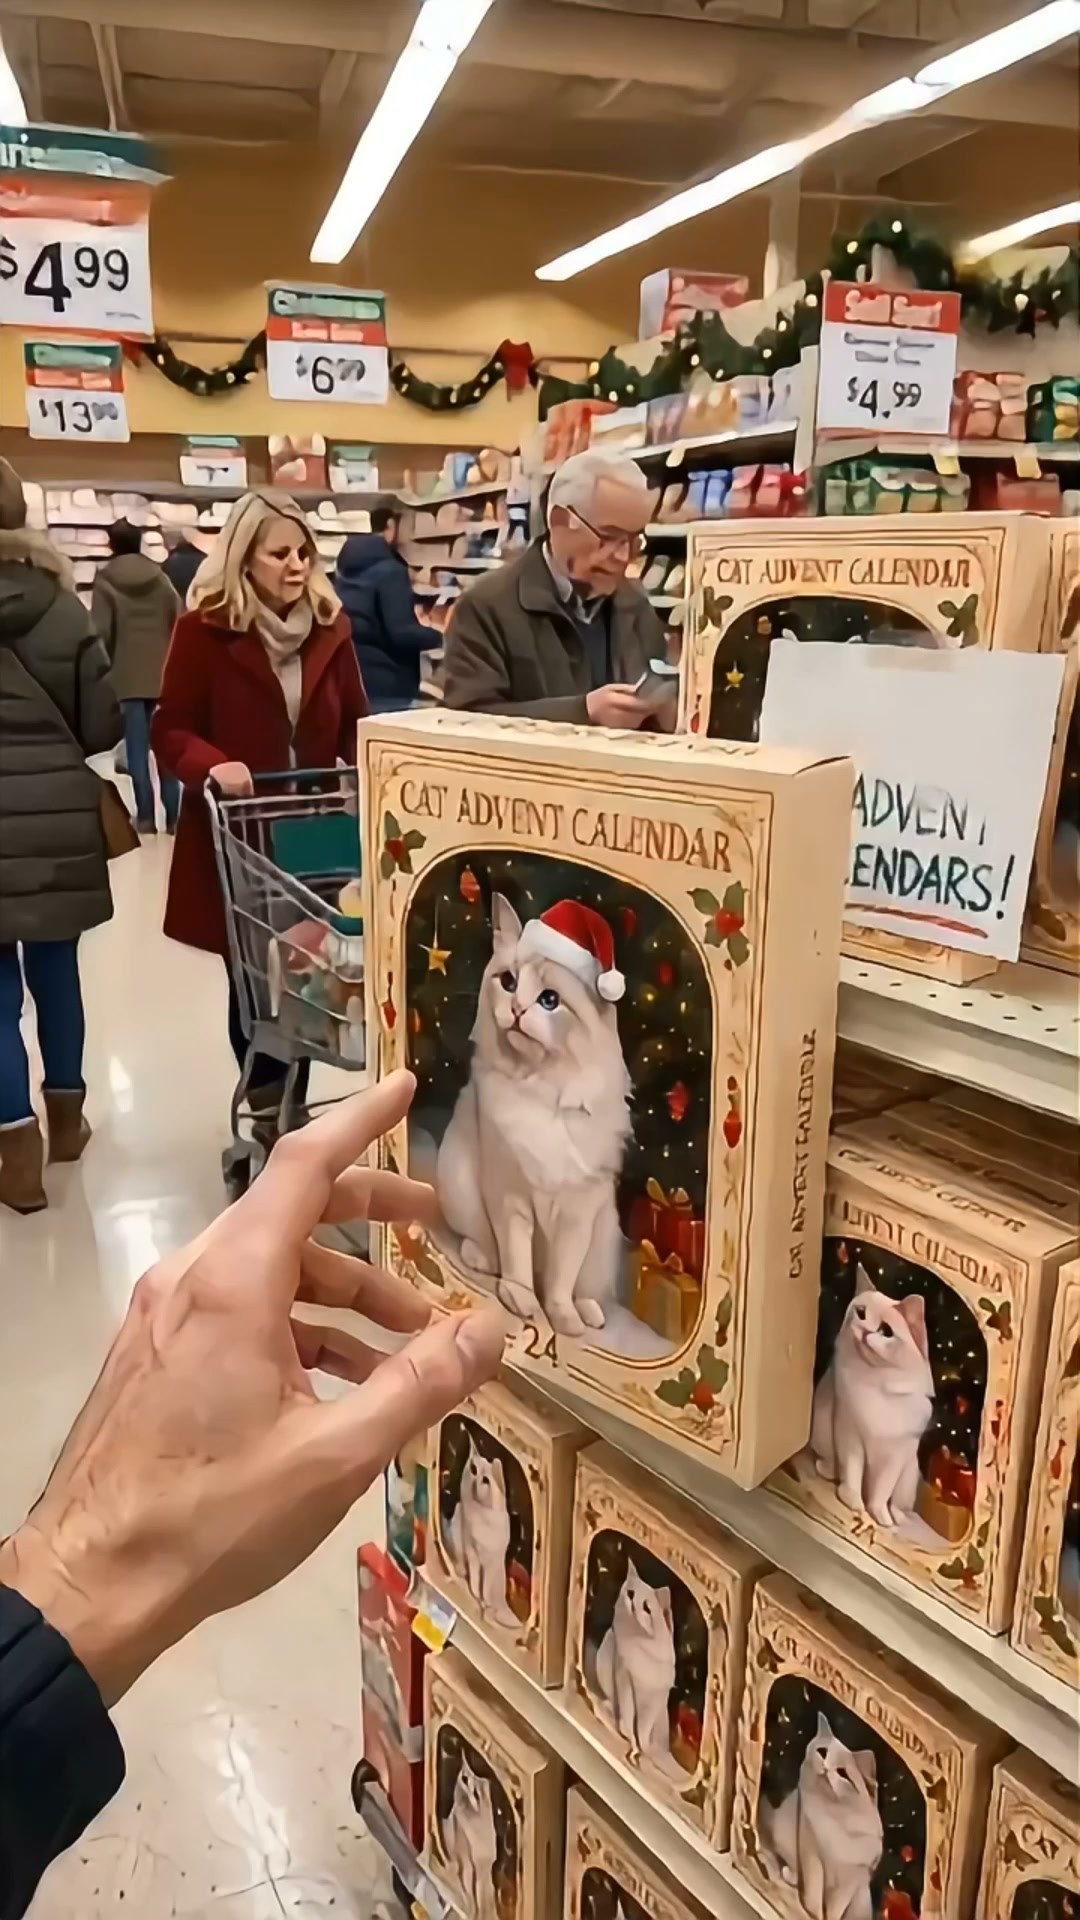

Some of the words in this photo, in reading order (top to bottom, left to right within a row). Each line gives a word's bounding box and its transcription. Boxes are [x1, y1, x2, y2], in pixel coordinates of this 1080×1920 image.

[847, 376, 922, 418] $4.99
[717, 559, 753, 585] CAT
[760, 559, 843, 585] ADVENT
[849, 558, 970, 588] CALENDAR
[400, 780, 448, 818] CAT
[457, 788, 564, 840] ADVENT
[572, 808, 731, 873] CALENDAR
[845, 844, 1014, 920] ENDARS!
[523, 1323, 558, 1368] 24
